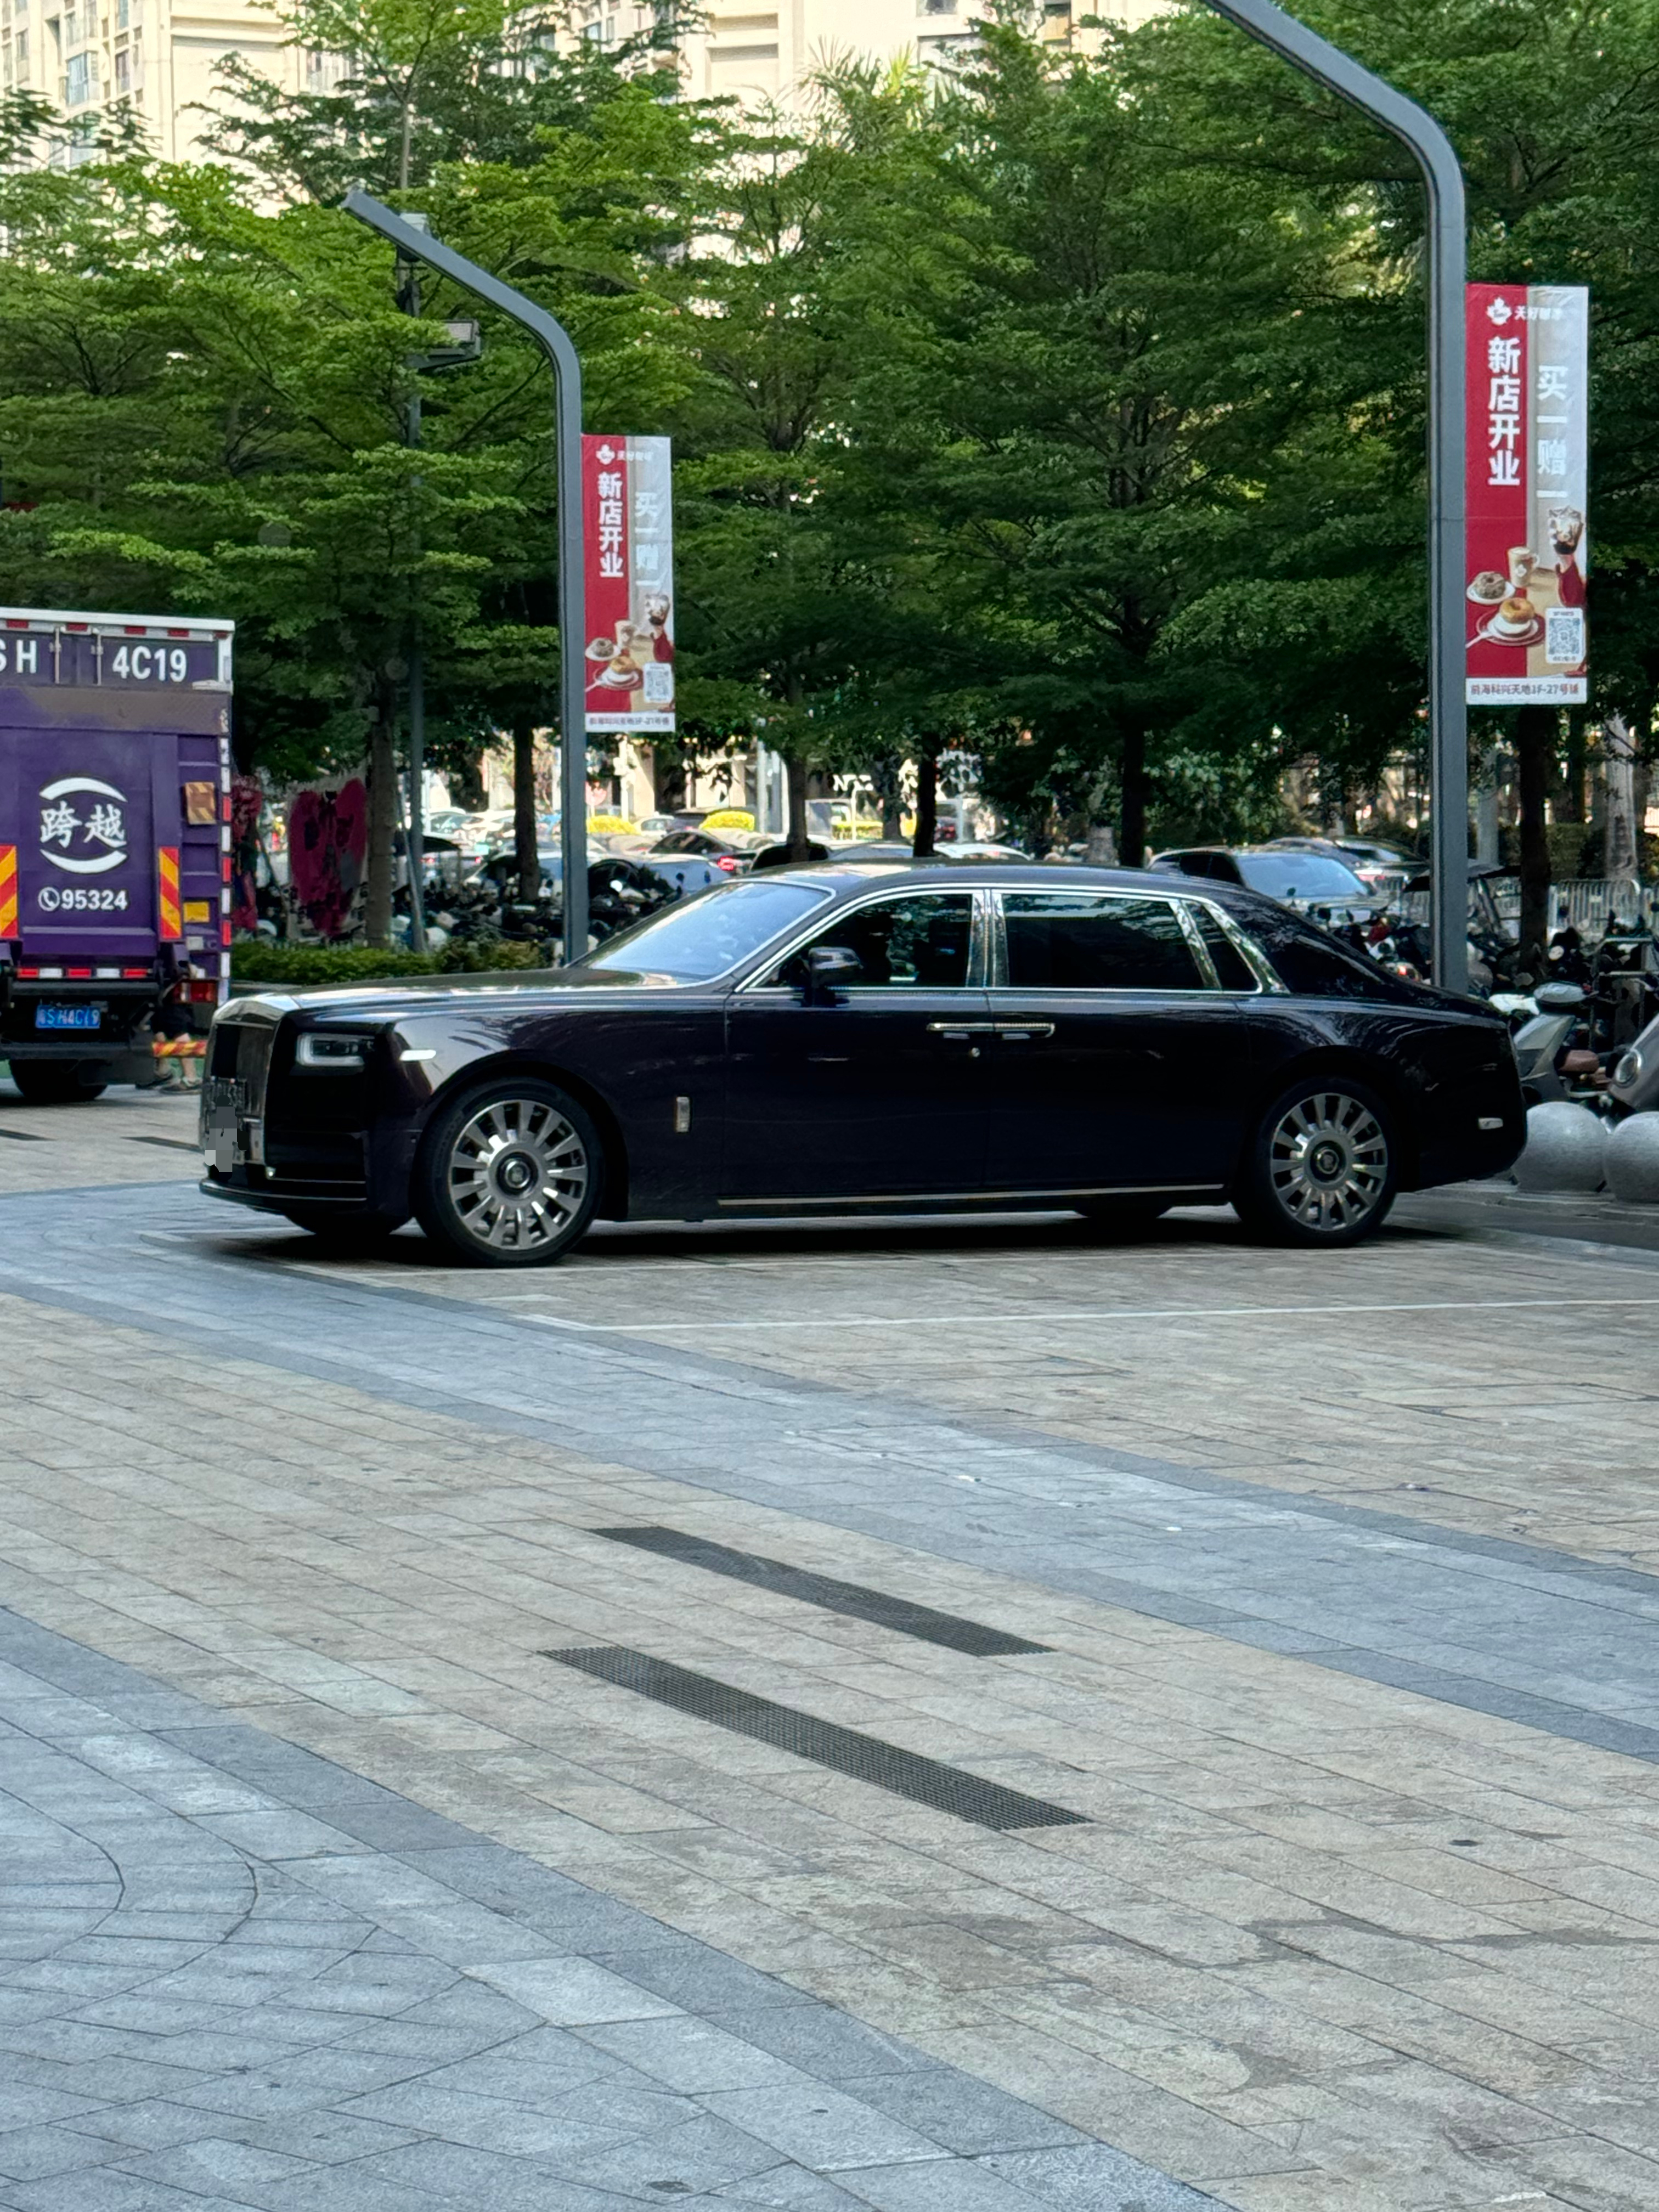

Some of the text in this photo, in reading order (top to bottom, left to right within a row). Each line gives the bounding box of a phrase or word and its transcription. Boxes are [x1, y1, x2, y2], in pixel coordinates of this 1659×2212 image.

[1487, 336, 1521, 486] 新店开业
[1536, 364, 1568, 499] 买一赠一
[597, 472, 624, 578] 新店开业
[112, 646, 187, 682] 4C19
[40, 800, 127, 848] 跨越
[61, 889, 128, 910] 95324
